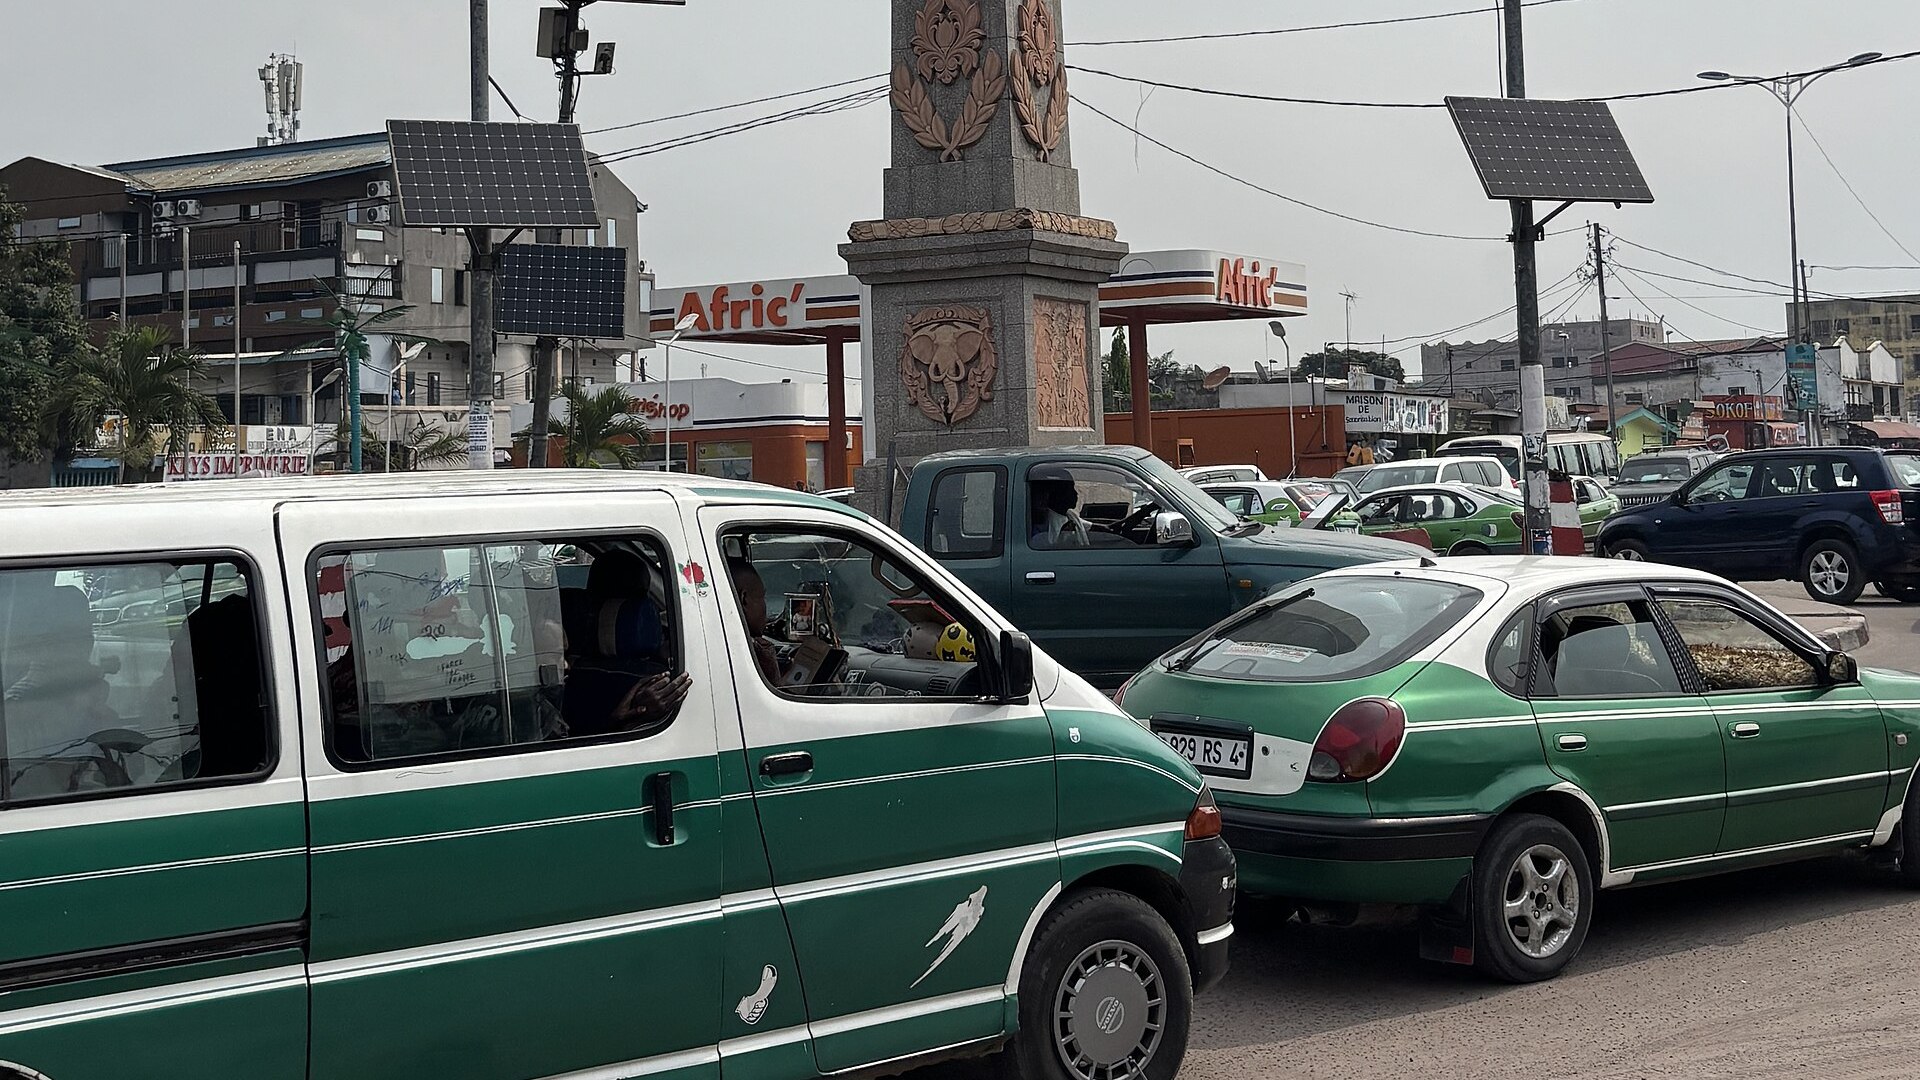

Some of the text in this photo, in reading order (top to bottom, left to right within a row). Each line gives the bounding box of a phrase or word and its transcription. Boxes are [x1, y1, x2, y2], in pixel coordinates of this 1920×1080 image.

[1216, 257, 1278, 307] Afric'
[677, 283, 805, 332] Afric'
[1346, 395, 1383, 405] MAISON
[1358, 405, 1370, 413] DE
[266, 427, 297, 441] ENA
[1203, 739, 1223, 764] RS
[1229, 742, 1239, 766] 4
[1101, 1000, 1119, 1030] VOLVO
